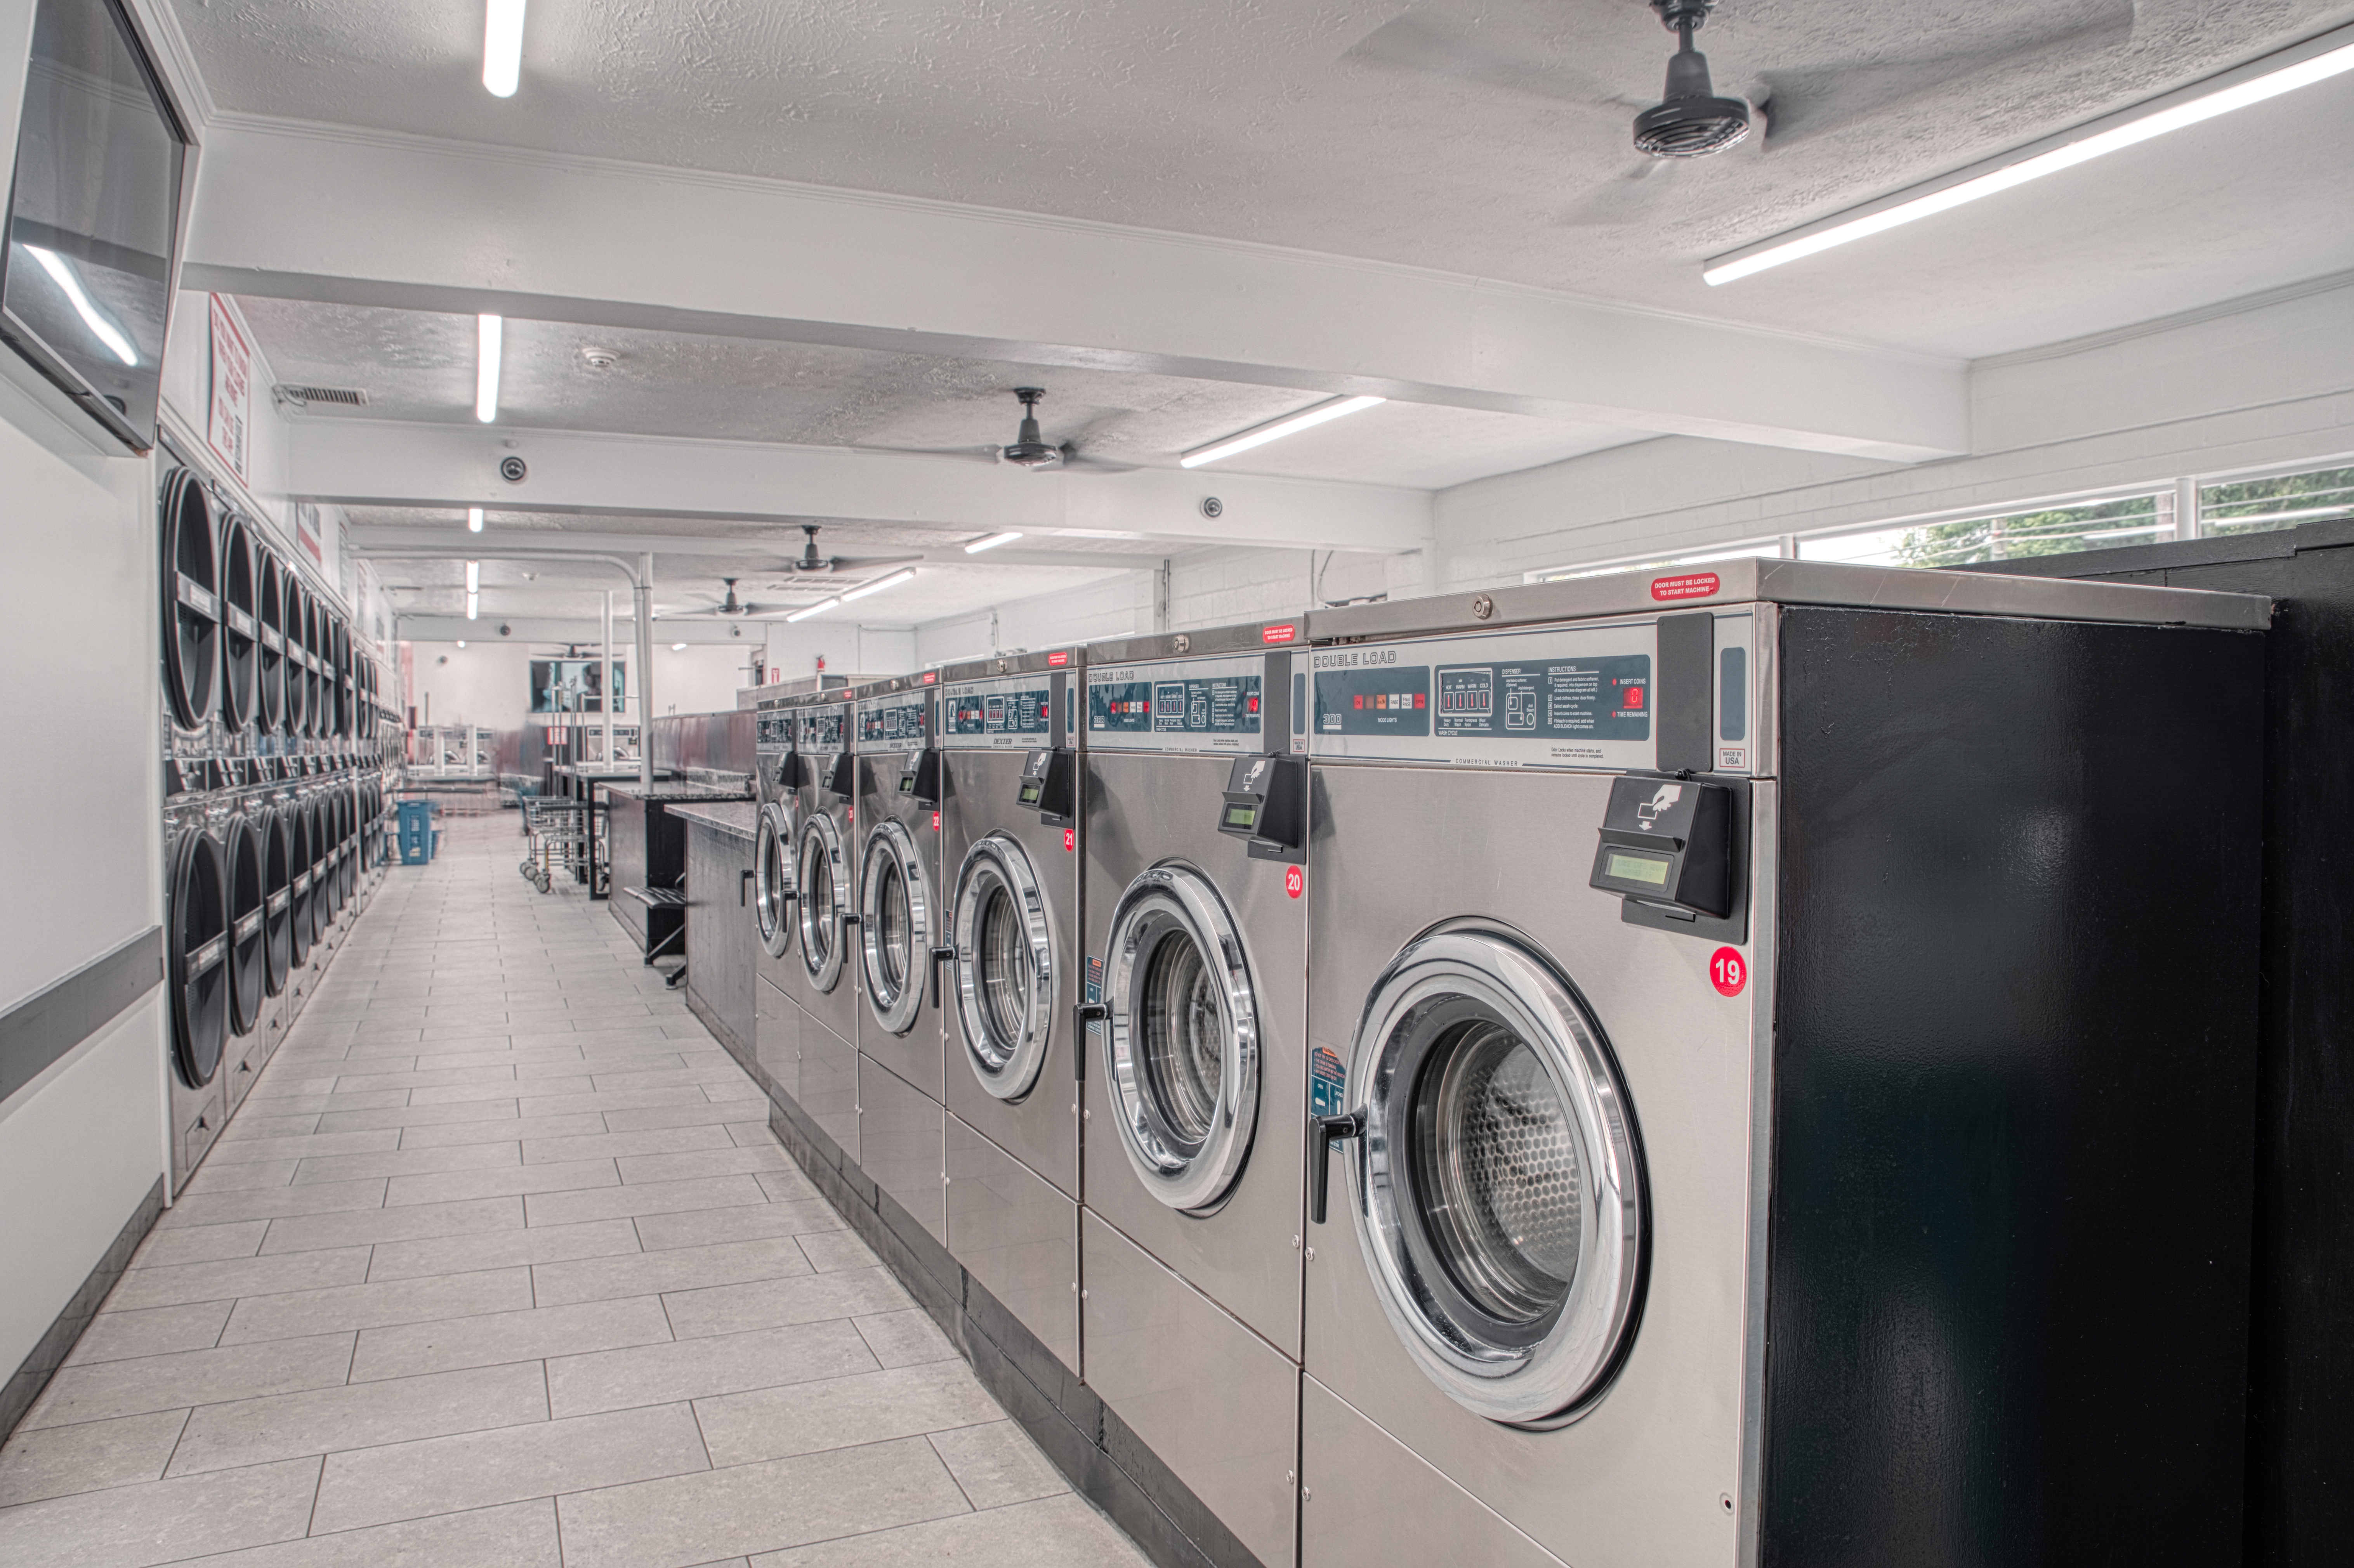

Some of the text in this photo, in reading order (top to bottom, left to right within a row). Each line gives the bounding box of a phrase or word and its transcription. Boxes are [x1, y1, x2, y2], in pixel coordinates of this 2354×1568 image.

[1314, 651, 1396, 668] DOUBLE LOAD
[1089, 671, 1134, 682] DOUBLE LOAD
[1632, 689, 1638, 703] 0
[1323, 714, 1342, 724] 300
[934, 816, 939, 826] 22
[1066, 833, 1072, 846] 21
[1288, 874, 1300, 891] 20
[1715, 958, 1739, 985] 19
